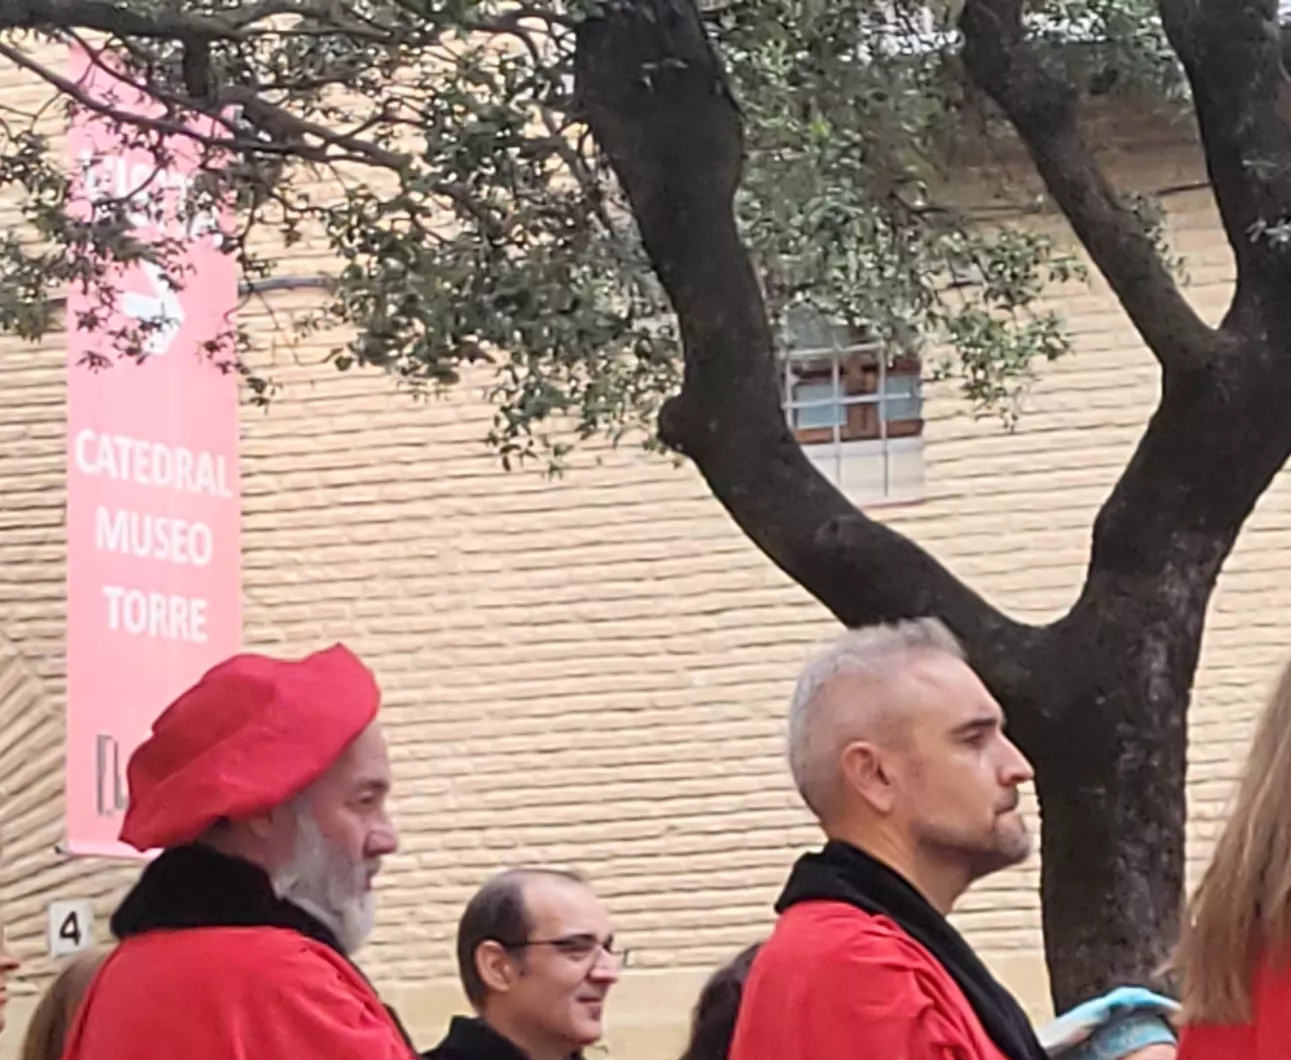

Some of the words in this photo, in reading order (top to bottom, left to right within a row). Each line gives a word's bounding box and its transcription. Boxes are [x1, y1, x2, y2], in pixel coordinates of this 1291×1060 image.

[75, 428, 232, 498] CATEDRAL
[95, 505, 213, 567] MUSEO
[102, 585, 208, 643] TORRE
[59, 910, 81, 946] 4
